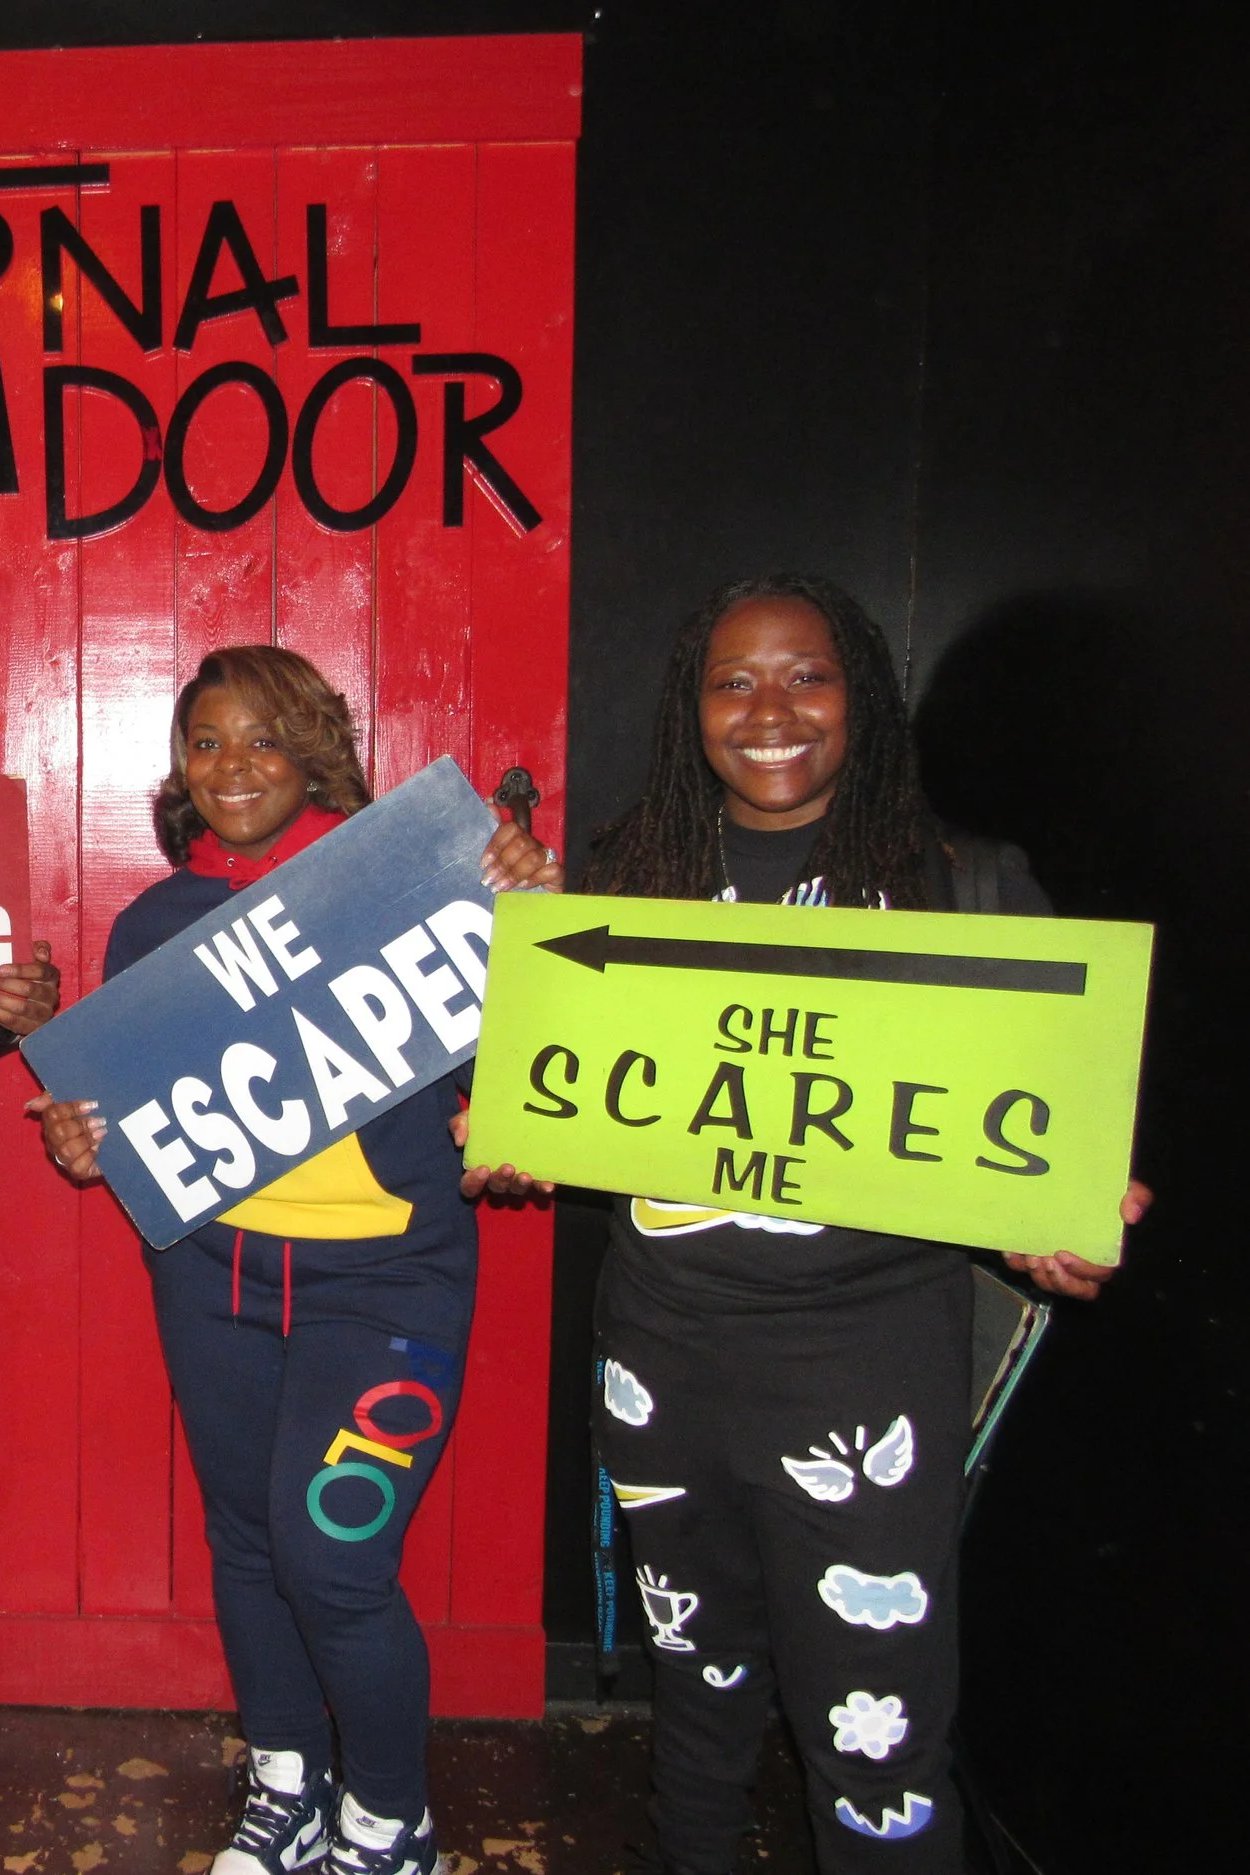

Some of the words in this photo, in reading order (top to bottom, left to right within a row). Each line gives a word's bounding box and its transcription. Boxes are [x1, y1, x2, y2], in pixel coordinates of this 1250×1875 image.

[42, 352, 544, 541] DOOR
[193, 895, 322, 1012] WE
[713, 1003, 839, 1061] SHE
[523, 1044, 1051, 1176] SCARES
[711, 1148, 807, 1205] ME
[307, 1336, 455, 1542] POLO
